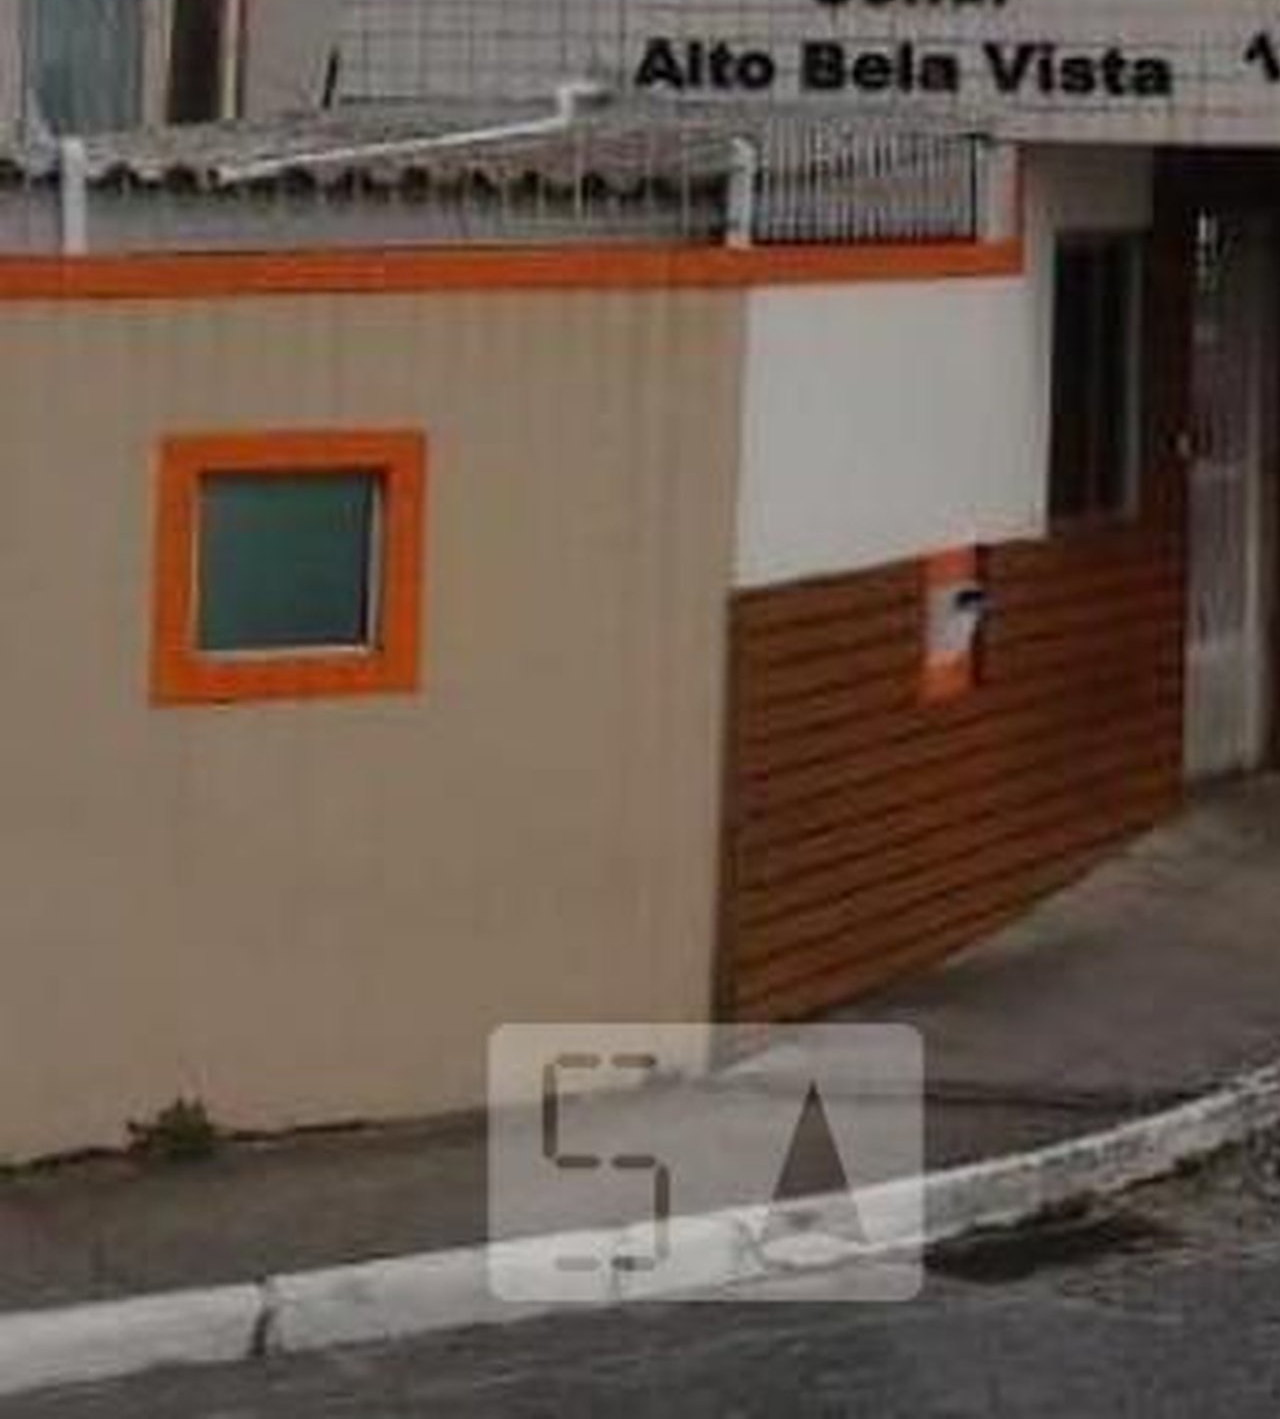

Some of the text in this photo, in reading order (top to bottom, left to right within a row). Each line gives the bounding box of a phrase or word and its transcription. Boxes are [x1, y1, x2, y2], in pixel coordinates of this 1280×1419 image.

[636, 37, 1175, 97] Alto Bela Vista
